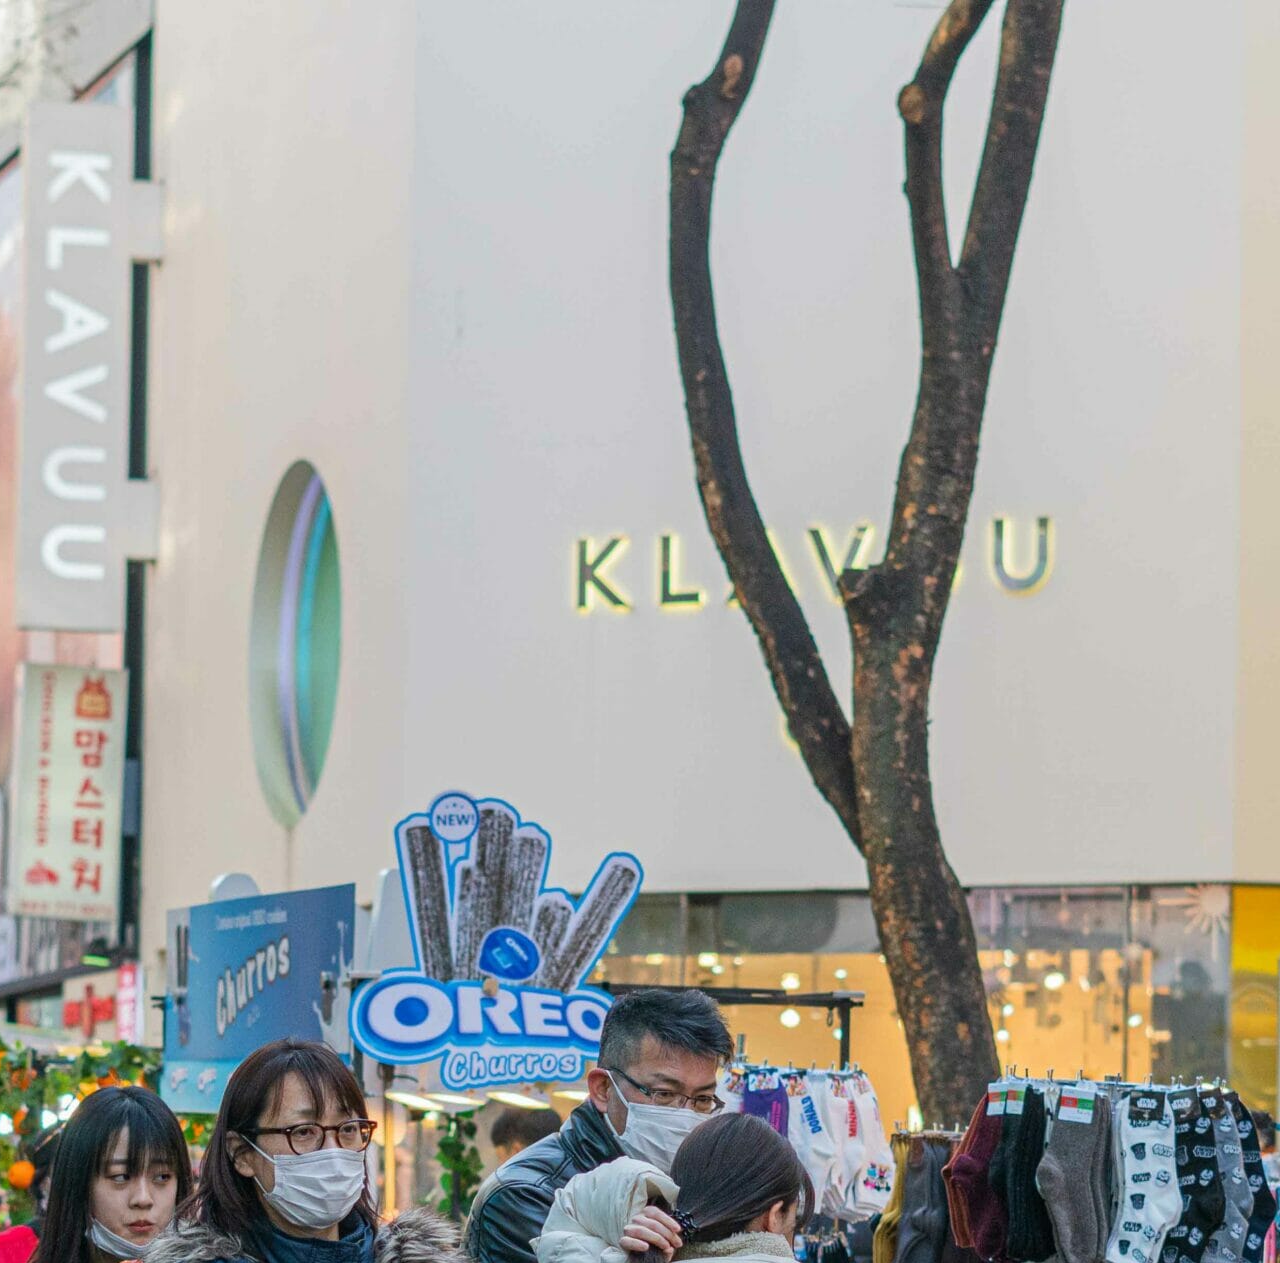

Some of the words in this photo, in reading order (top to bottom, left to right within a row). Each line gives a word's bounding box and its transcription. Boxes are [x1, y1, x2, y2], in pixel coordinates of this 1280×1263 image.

[42, 151, 112, 581] KLAVUU
[577, 516, 1051, 611] KLVU
[70, 728, 111, 895] 맘스터치
[435, 813, 475, 827] NEW!
[215, 934, 291, 1039] Churros
[367, 982, 603, 1044] OREO
[449, 1051, 578, 1083] Churros
[801, 1095, 822, 1134] DONALD
